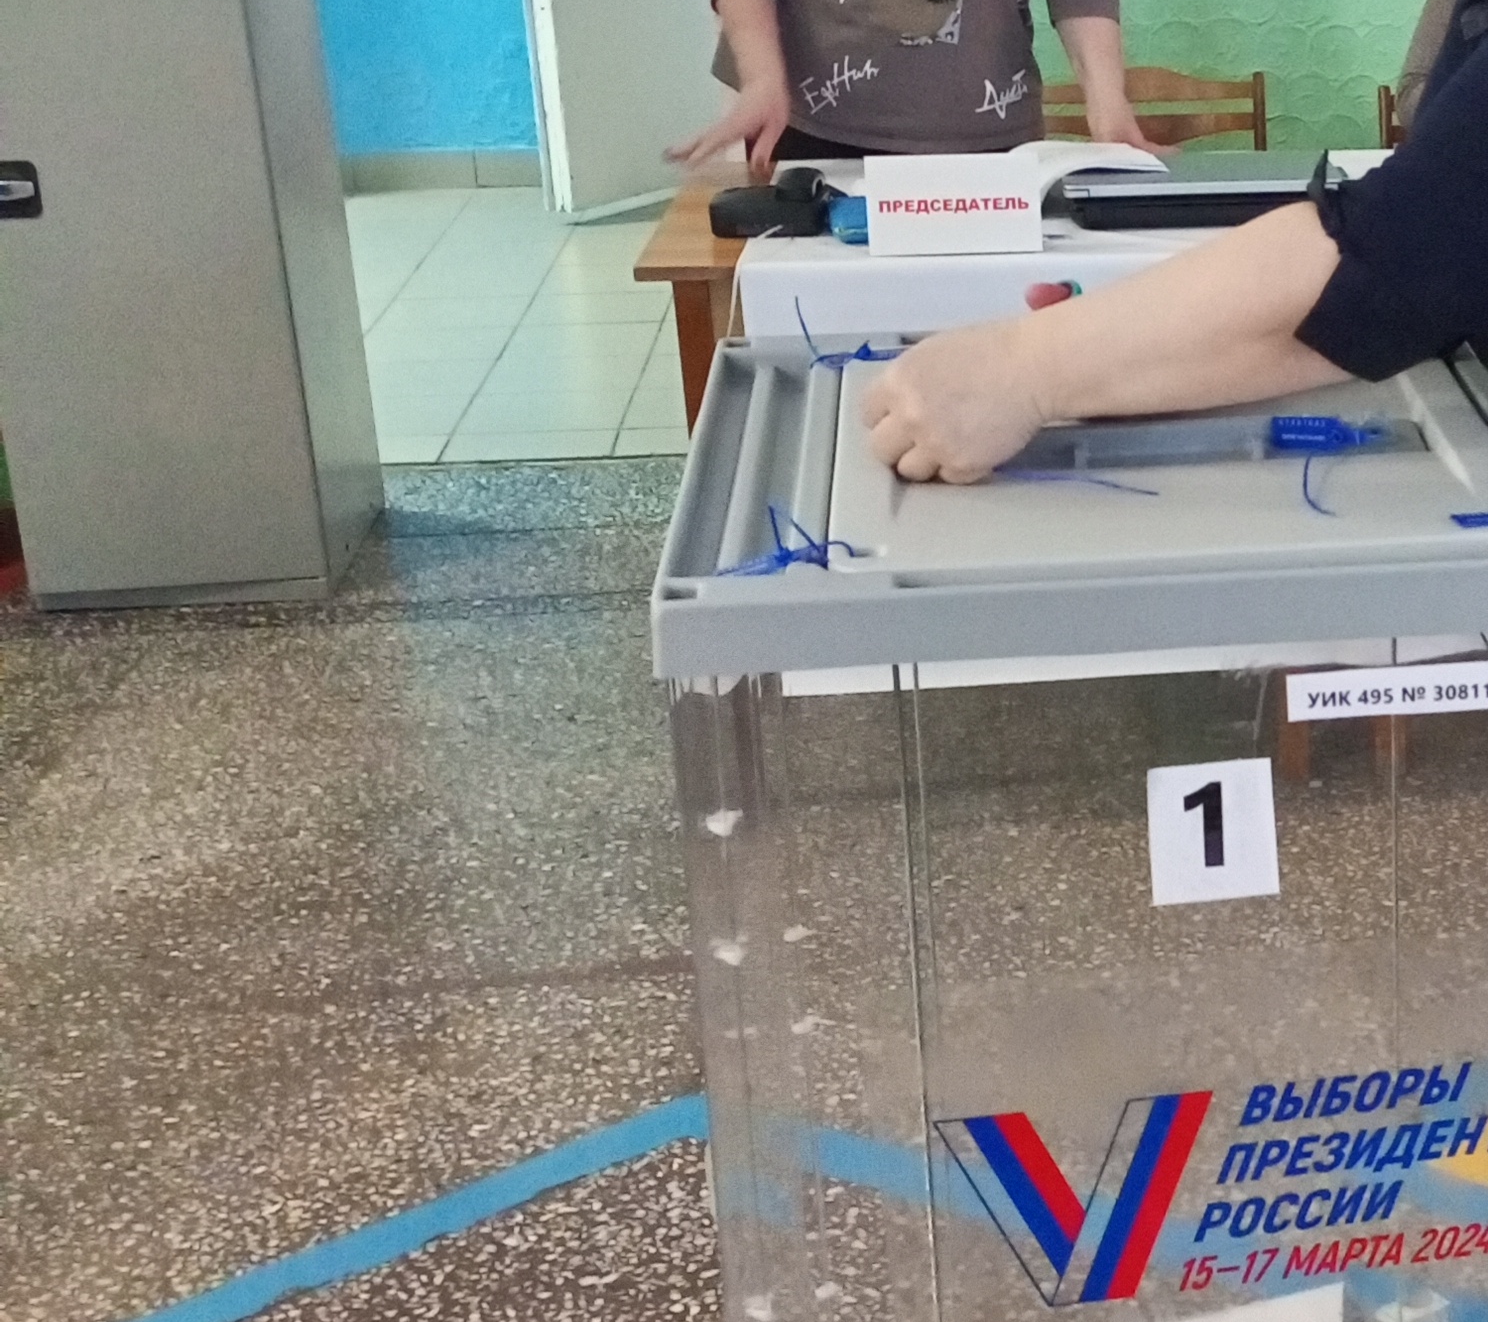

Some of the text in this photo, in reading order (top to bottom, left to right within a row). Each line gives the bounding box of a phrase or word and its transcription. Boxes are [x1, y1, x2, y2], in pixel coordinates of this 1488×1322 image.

[878, 196, 1029, 215] ПРЕДСЕДАТЕЛЬ
[1307, 691, 1351, 709] УИК
[1358, 687, 1394, 706] 495
[1401, 685, 1426, 704] №
[1183, 781, 1225, 868] 1
[1239, 1061, 1473, 1127] ВЫБОРЫ
[1194, 1180, 1405, 1243] РОССИИ
[1286, 1233, 1404, 1279] МАРТА
